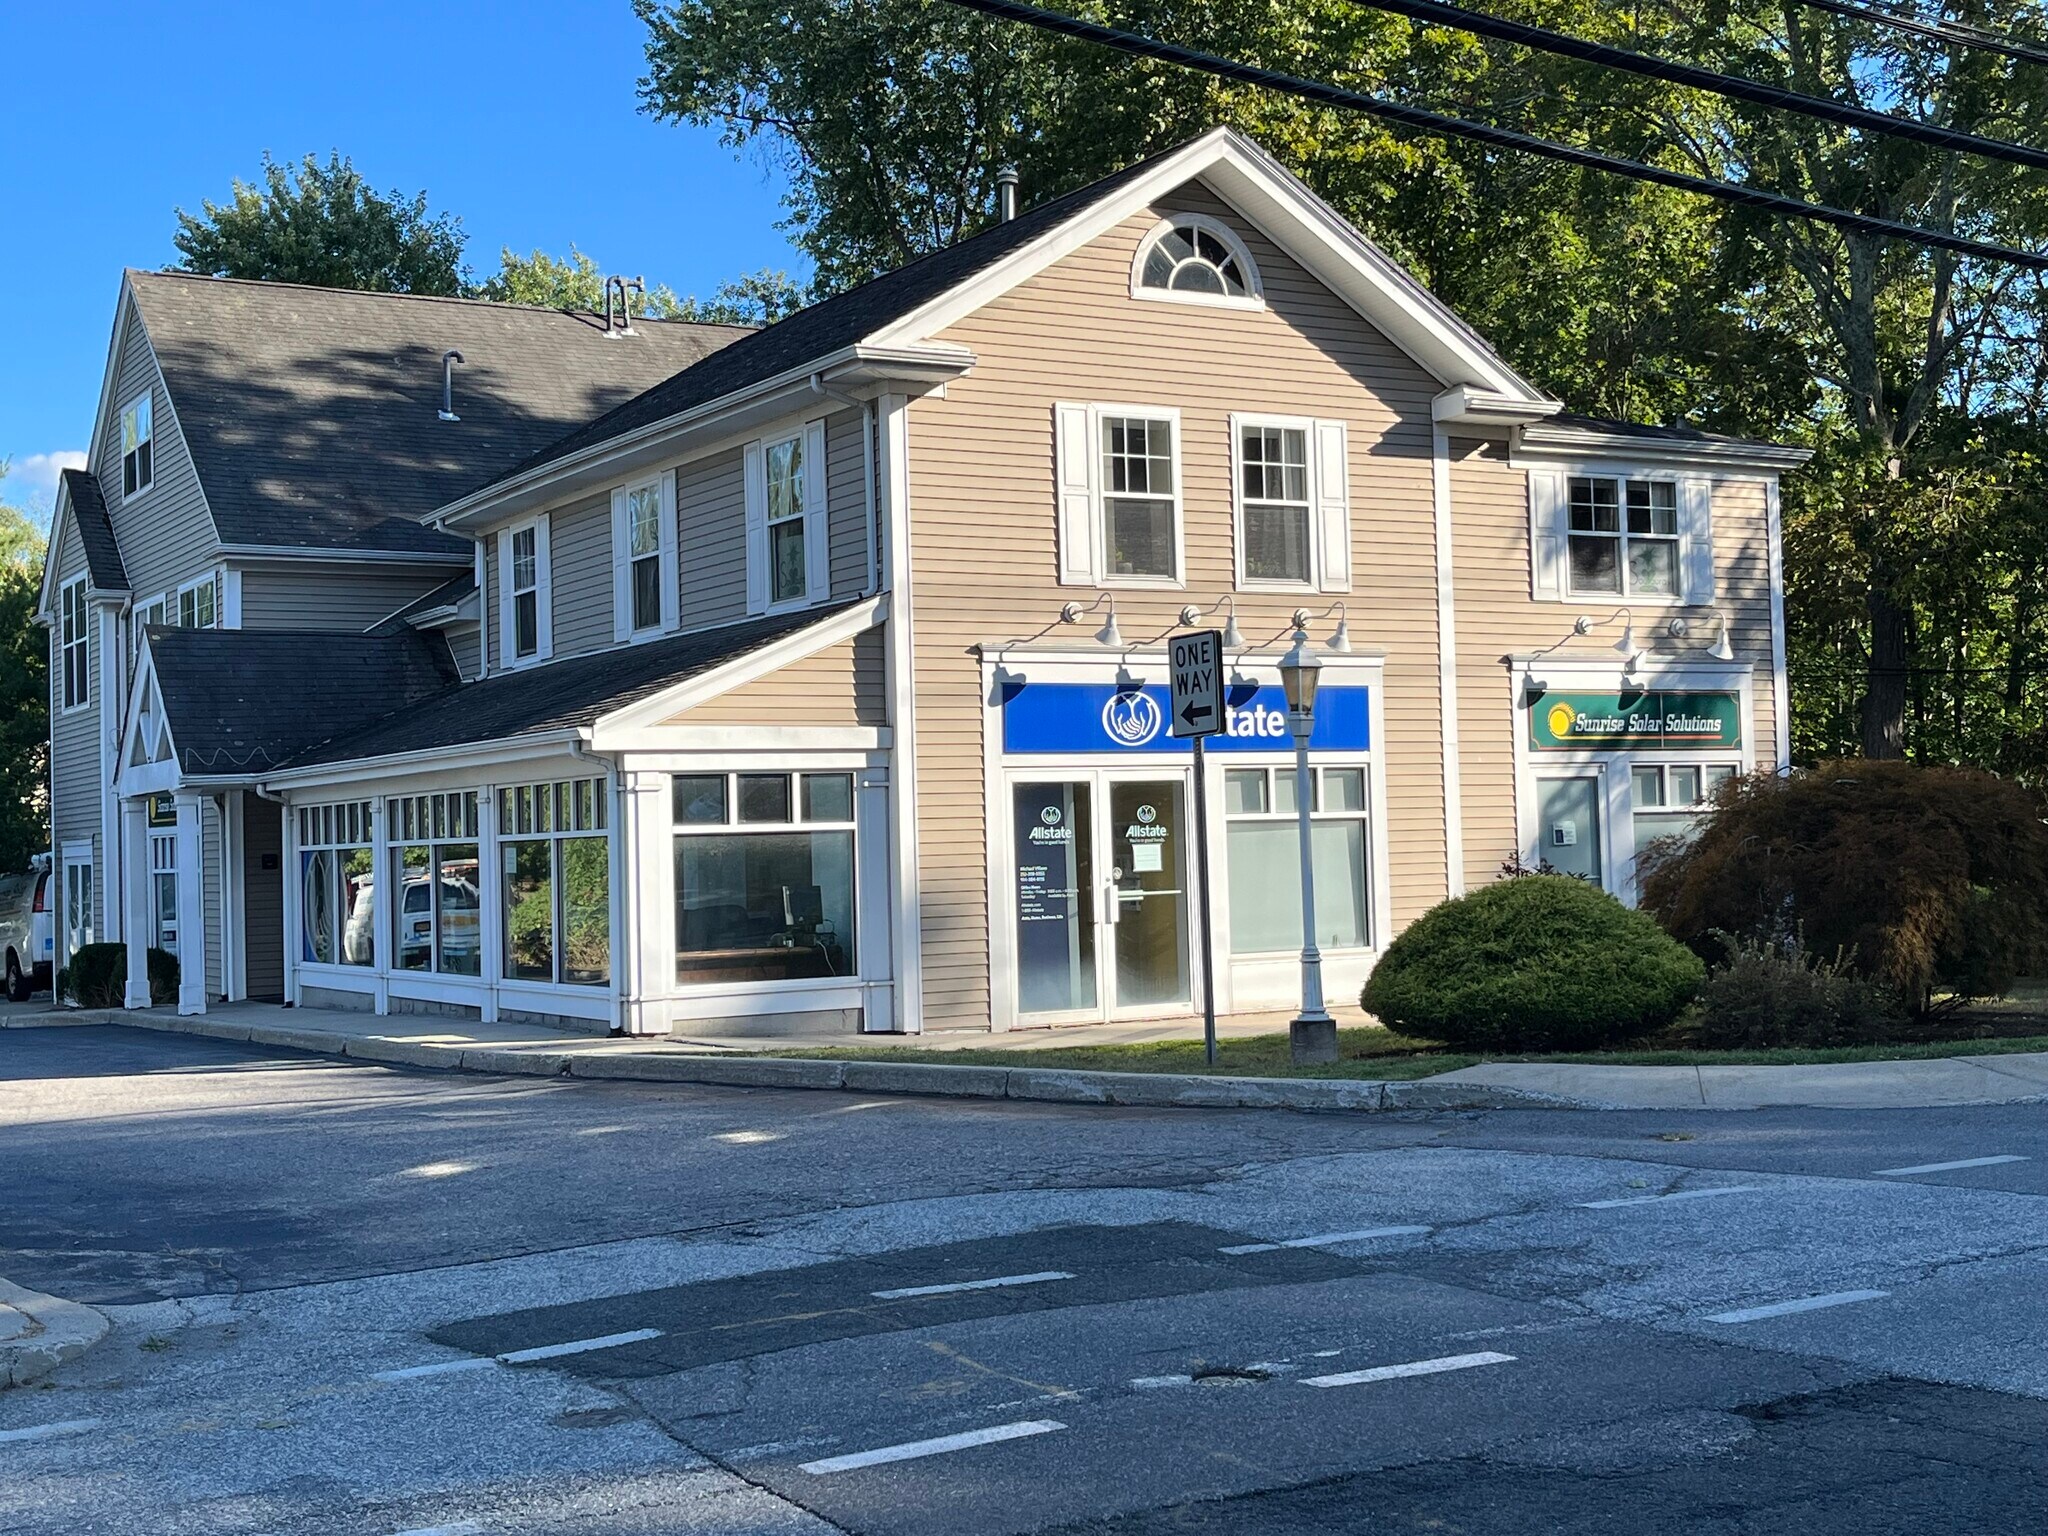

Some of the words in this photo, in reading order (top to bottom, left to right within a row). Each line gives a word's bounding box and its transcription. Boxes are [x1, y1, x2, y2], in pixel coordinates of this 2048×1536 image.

[1175, 641, 1210, 668] ONE
[1176, 668, 1212, 696] WAY
[1575, 713, 1624, 732] Sunrise
[1628, 713, 1661, 732] Solar
[1665, 713, 1722, 732] Solutions
[1029, 826, 1072, 839] Allstate
[1125, 825, 1168, 838] Allstate
